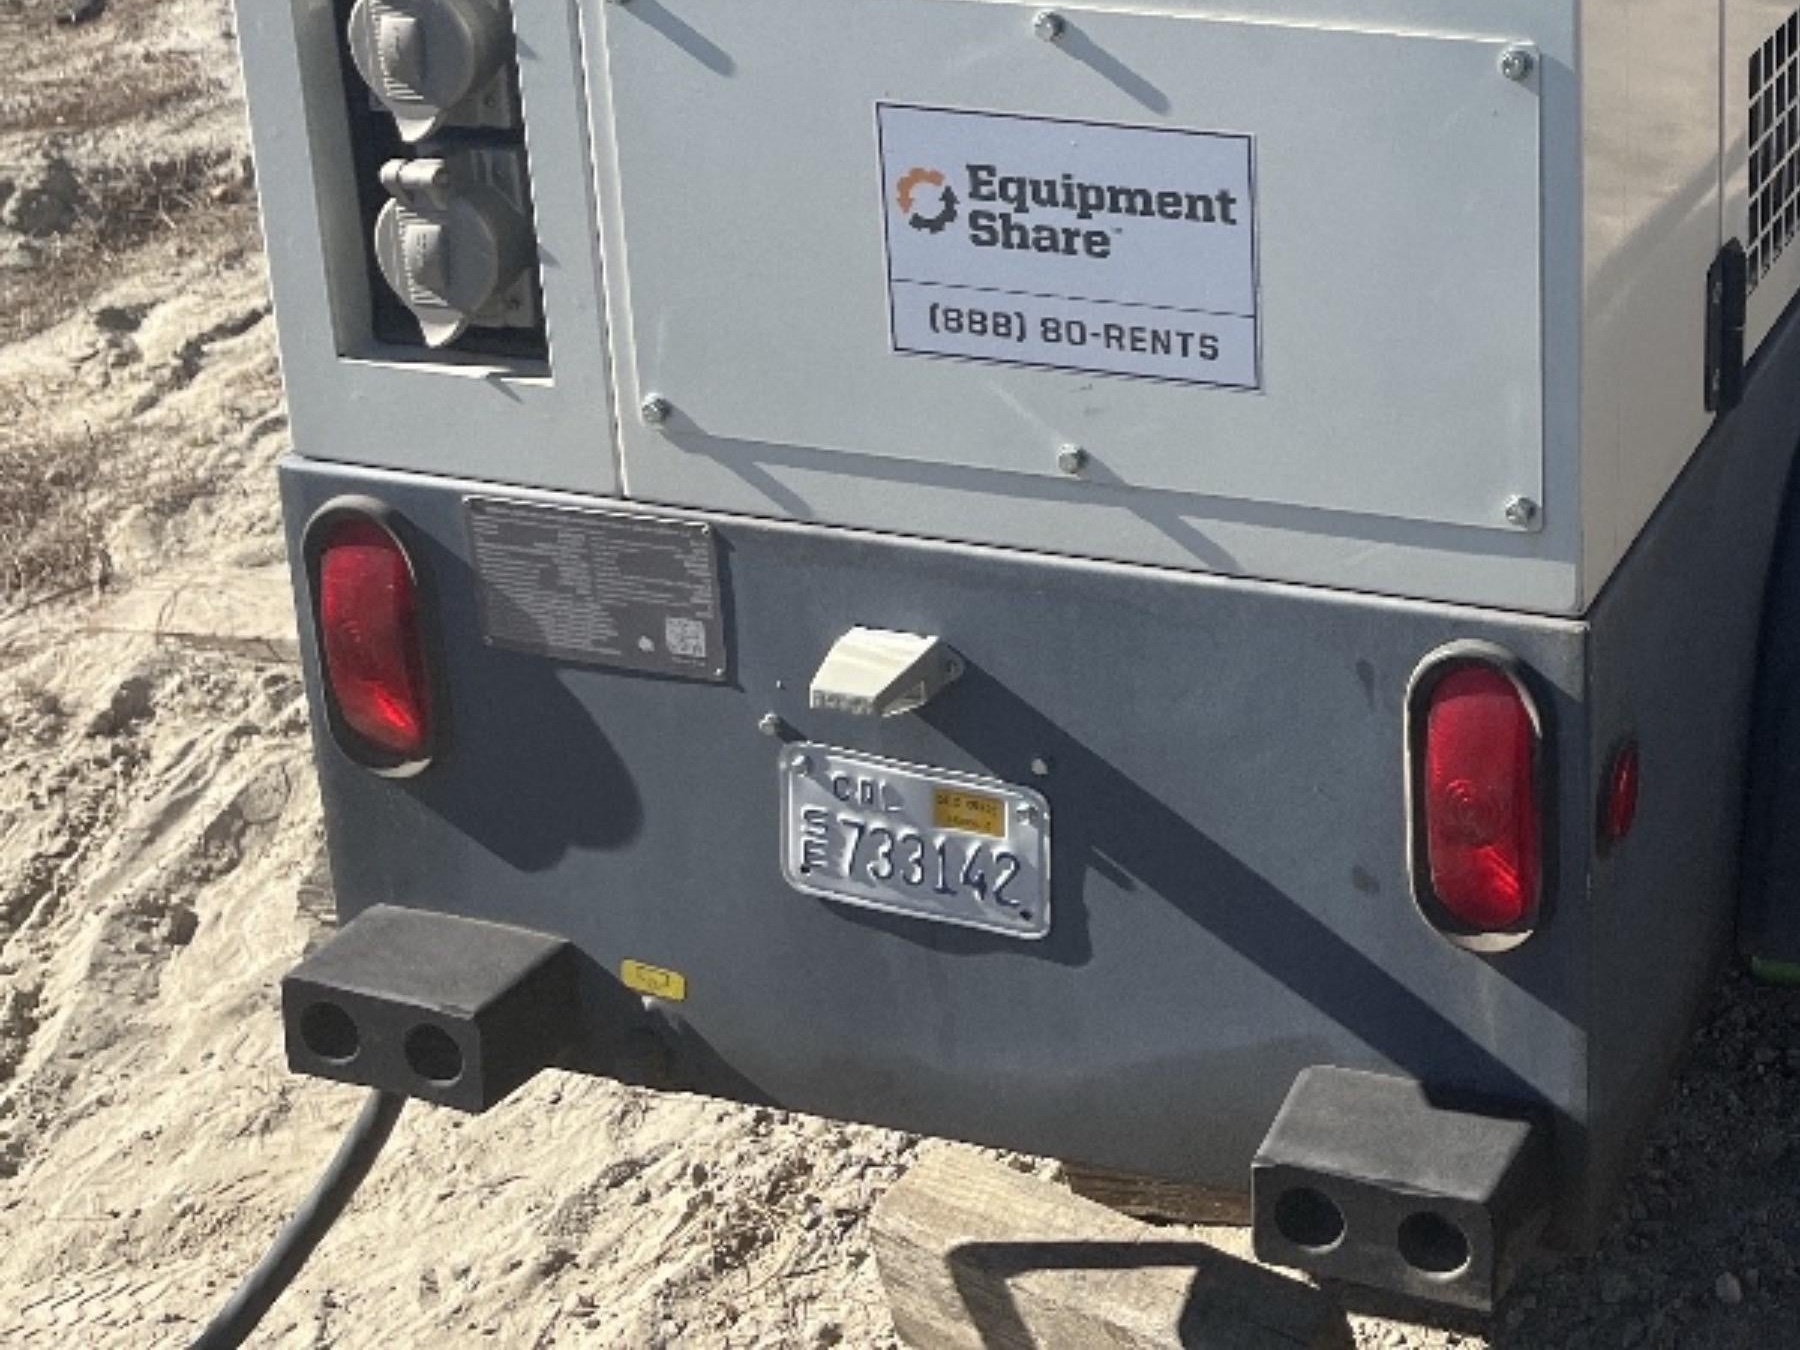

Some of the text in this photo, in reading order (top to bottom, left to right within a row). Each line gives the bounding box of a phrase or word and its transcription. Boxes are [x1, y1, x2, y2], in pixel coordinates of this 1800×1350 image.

[965, 163, 1238, 226] Equipment
[968, 209, 1112, 259] Share
[929, 302, 1220, 361] (888) 80-RENTS
[836, 812, 1022, 908] 733142
